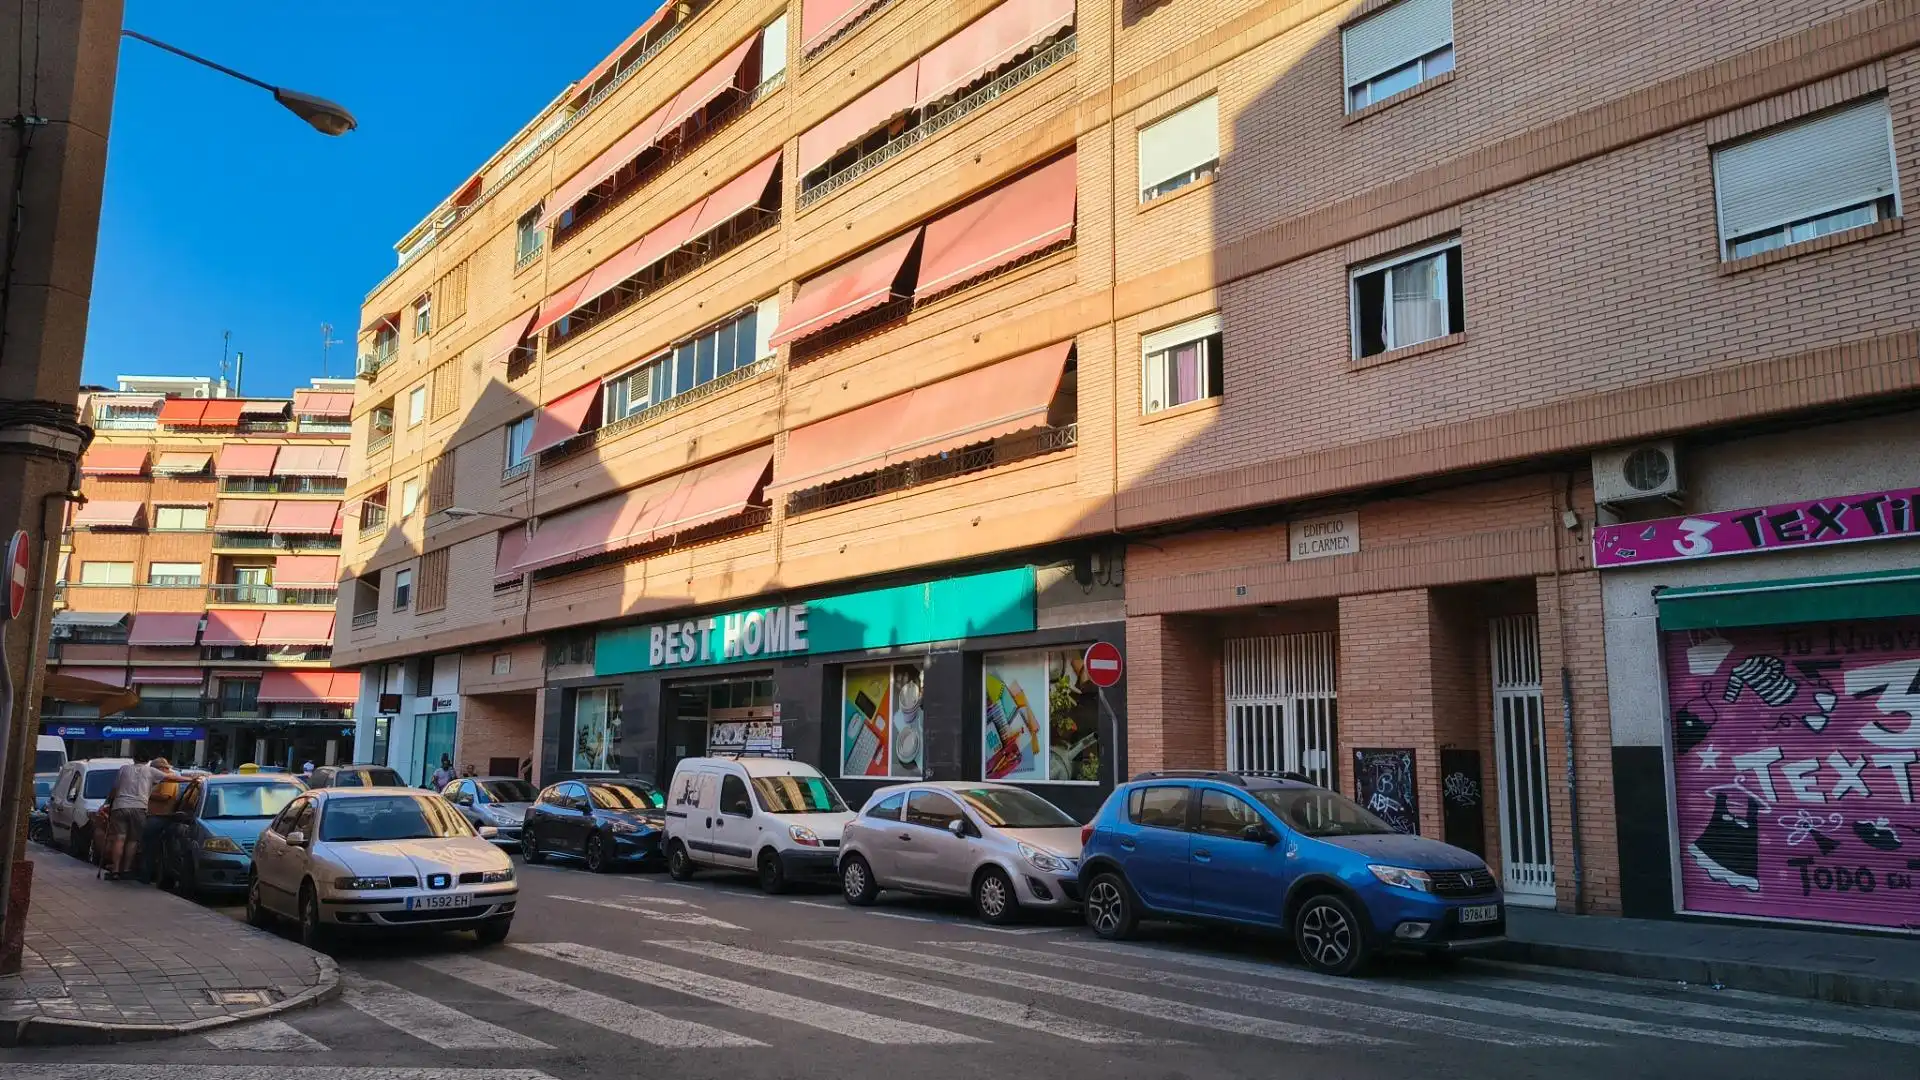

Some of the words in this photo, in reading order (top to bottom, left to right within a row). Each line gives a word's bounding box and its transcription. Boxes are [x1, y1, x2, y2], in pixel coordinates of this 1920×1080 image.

[1304, 520, 1344, 538] EDIFICIO
[1673, 518, 1721, 555] 3
[1299, 542, 1309, 555] EL
[1312, 536, 1349, 552] CARMEN
[650, 618, 716, 666] BEST
[724, 605, 809, 657] HOME
[1843, 658, 1920, 749] 3
[1788, 857, 1876, 896] TODO
[415, 899, 421, 908] A
[426, 896, 452, 908] 1592
[454, 895, 468, 906] EH
[1464, 907, 1484, 920] 9784
